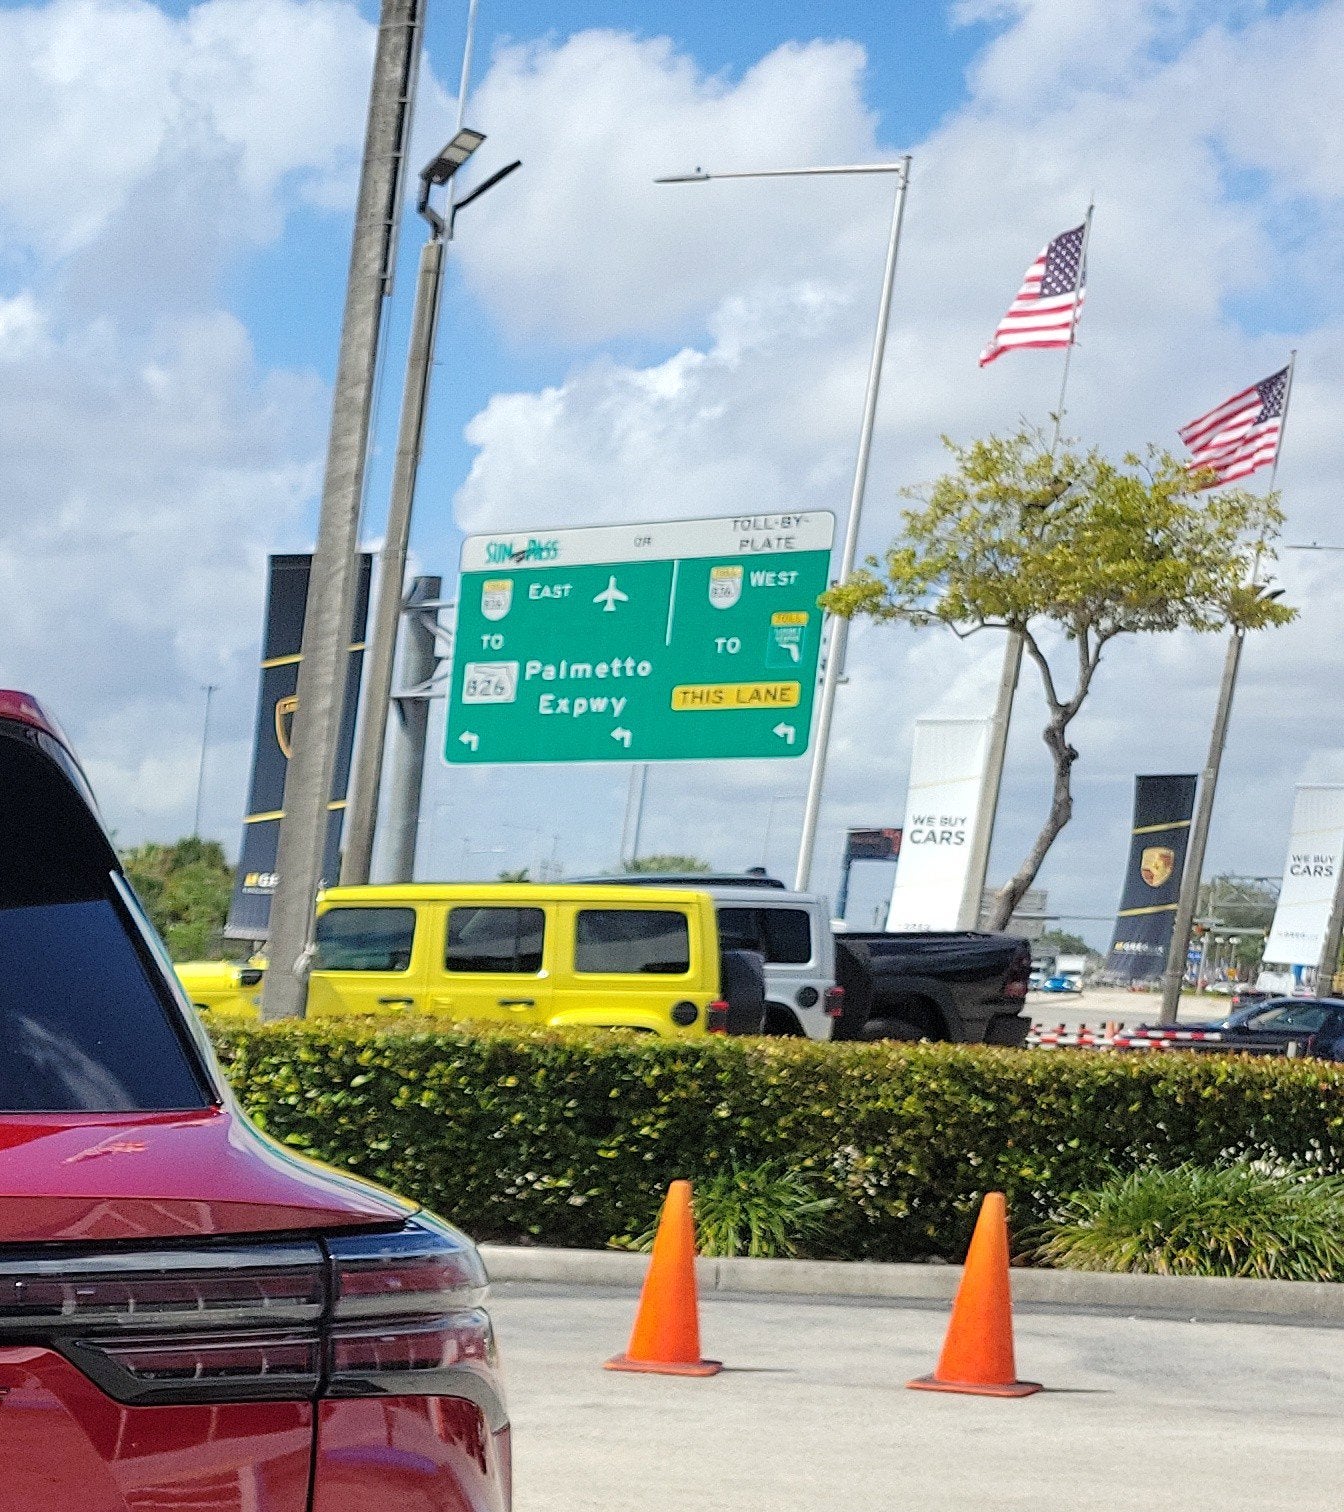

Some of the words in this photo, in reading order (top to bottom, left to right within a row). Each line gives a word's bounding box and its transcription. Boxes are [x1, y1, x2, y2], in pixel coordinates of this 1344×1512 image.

[739, 537, 796, 551] PLATE
[750, 571, 799, 588] WEST
[528, 583, 572, 600] EAST
[481, 634, 505, 651] TO
[714, 637, 742, 654] TO
[524, 656, 653, 681] Palmetto
[465, 679, 506, 697] 826
[680, 690, 724, 705] THIS
[736, 687, 792, 704] LANE
[538, 693, 628, 718] Expwy
[913, 815, 937, 827] WE
[940, 815, 968, 828] BUY
[909, 829, 966, 846] CARS
[1291, 854, 1311, 863] WE
[1313, 855, 1335, 865] BUY
[1289, 864, 1334, 877] CARS
